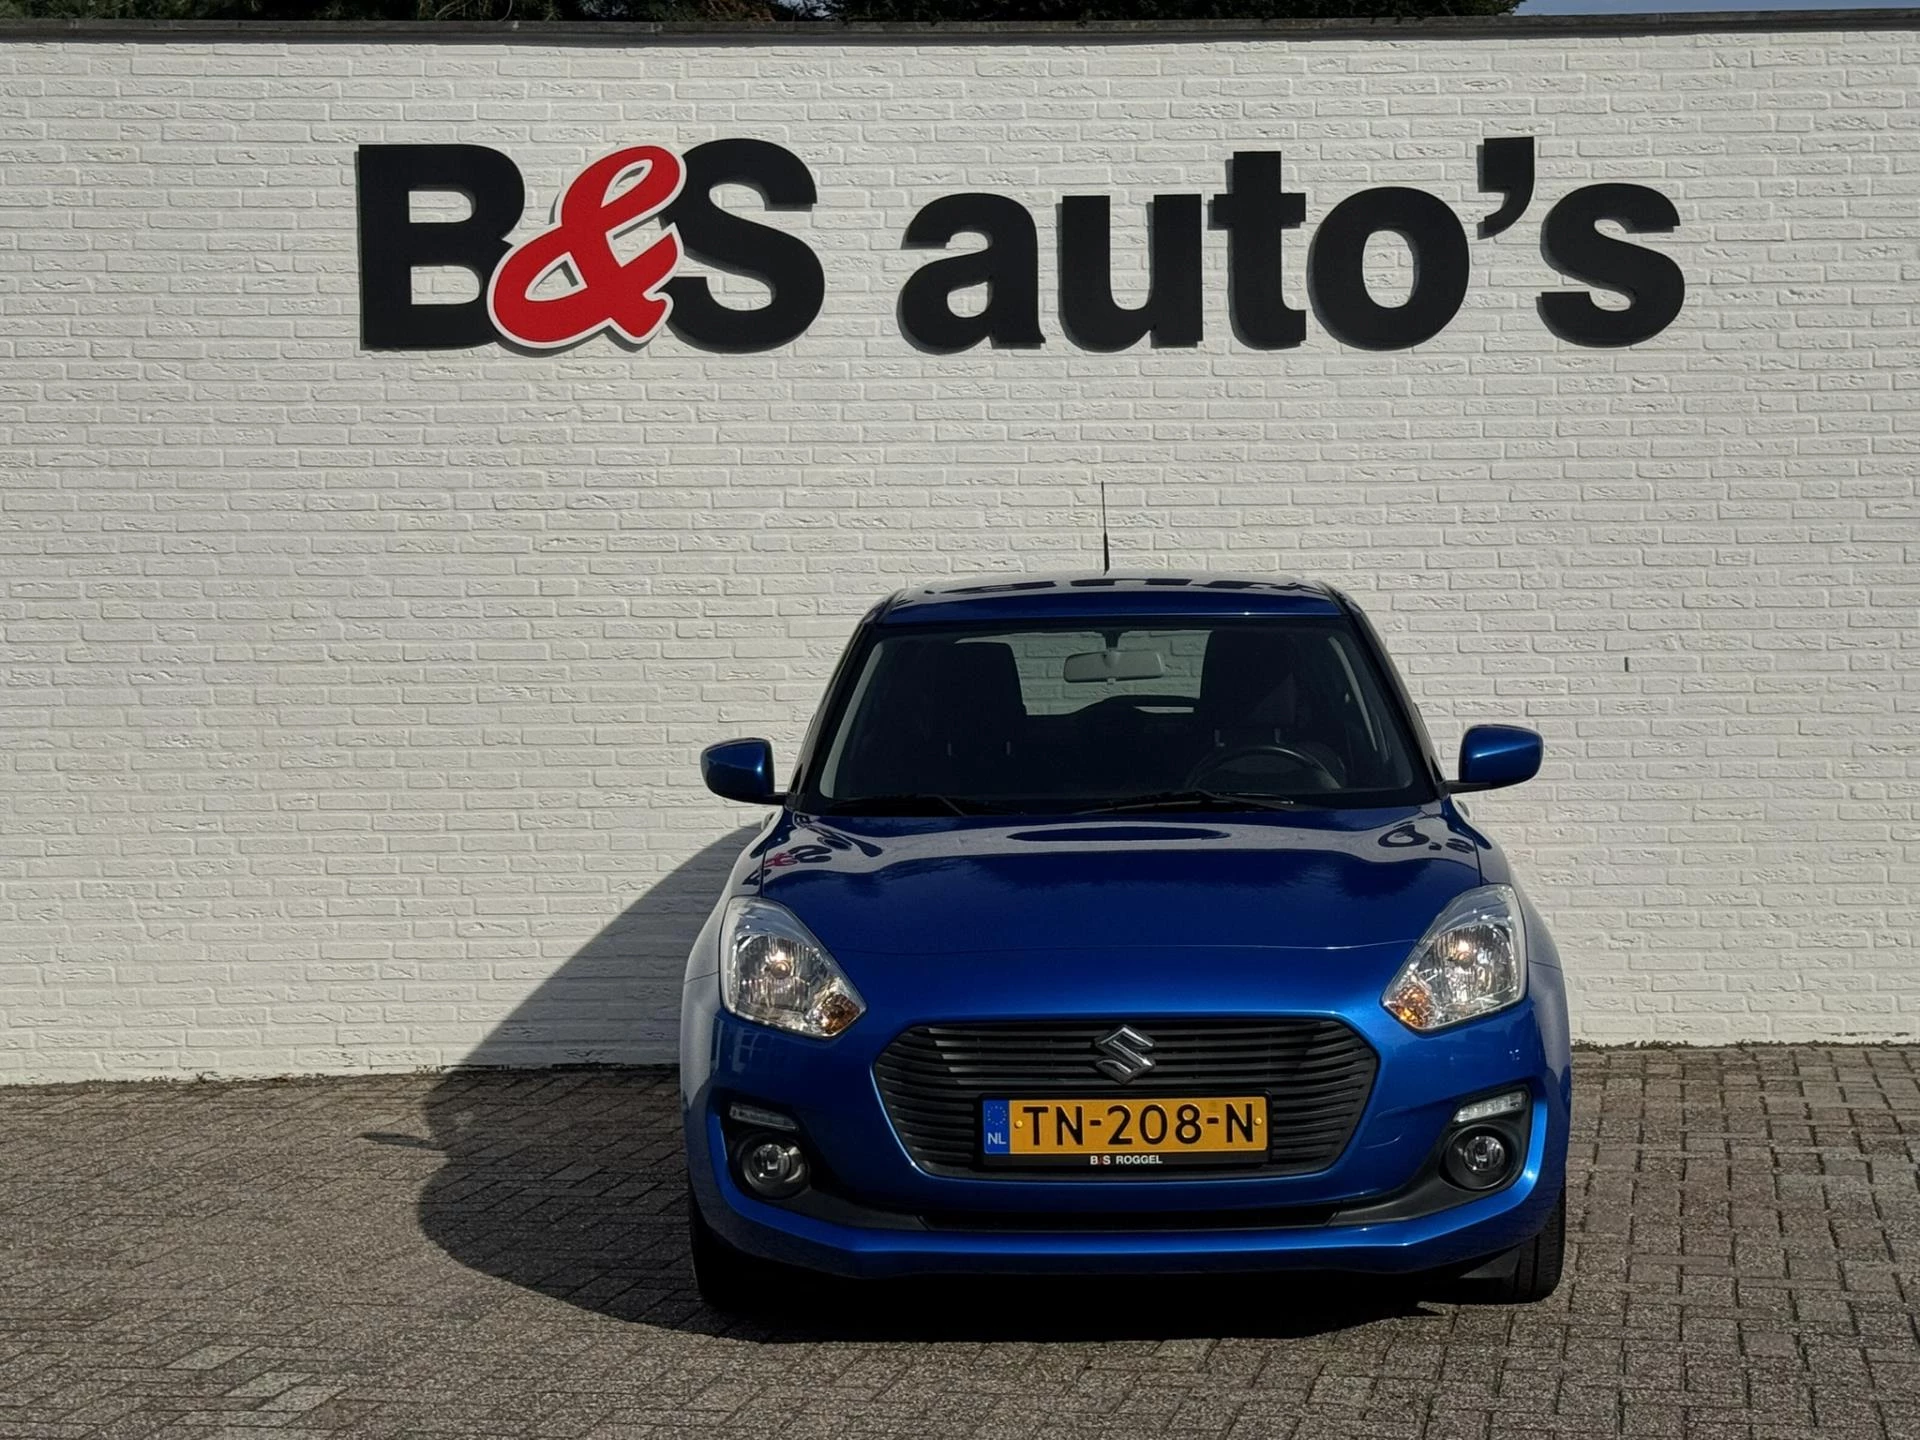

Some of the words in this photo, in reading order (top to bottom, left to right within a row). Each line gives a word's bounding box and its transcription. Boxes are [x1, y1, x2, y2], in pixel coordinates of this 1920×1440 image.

[357, 138, 825, 353] B&S
[897, 136, 1686, 350] auto's
[987, 1132, 1007, 1145] NL
[1022, 1103, 1254, 1146] TN-208-N
[1115, 1154, 1163, 1165] ROGGEL
